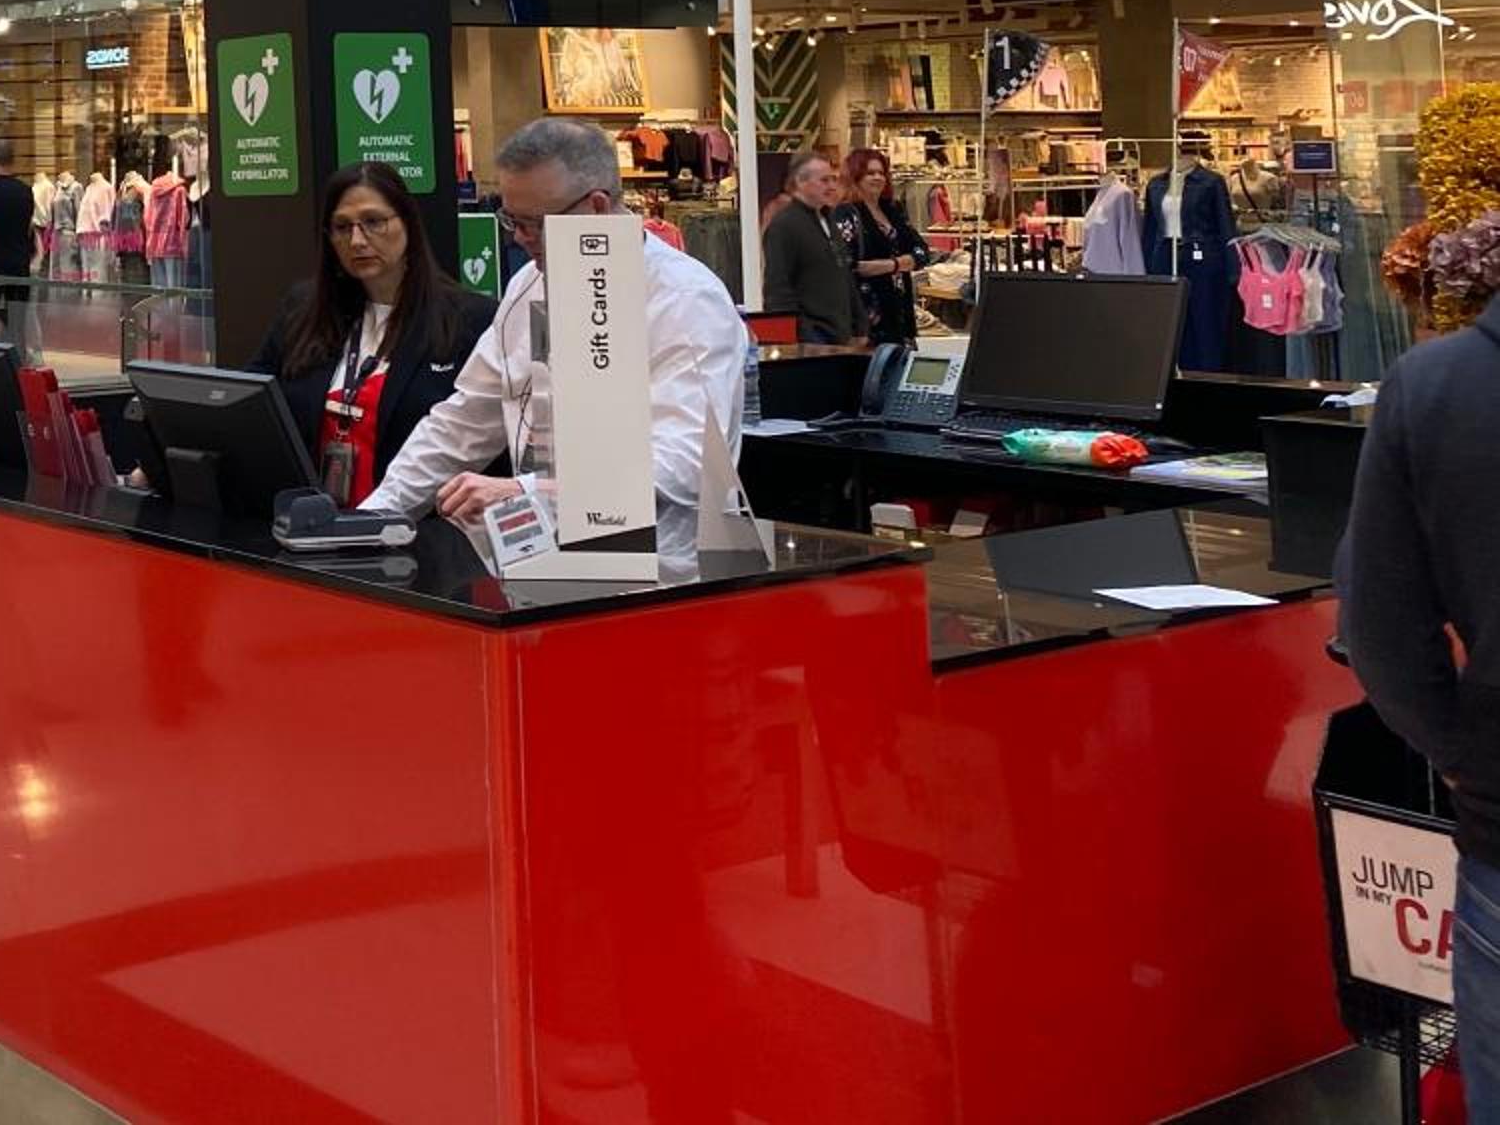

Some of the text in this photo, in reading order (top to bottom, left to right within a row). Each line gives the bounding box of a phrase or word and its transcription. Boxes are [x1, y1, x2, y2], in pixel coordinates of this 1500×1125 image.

[236, 136, 281, 149] AUTOMATIC
[358, 135, 414, 147] AUTOMATIC
[239, 152, 277, 165] EXTERNAL
[588, 267, 610, 370] Gift Cards
[1352, 855, 1433, 898] JUMP
[1373, 890, 1392, 906] MY
